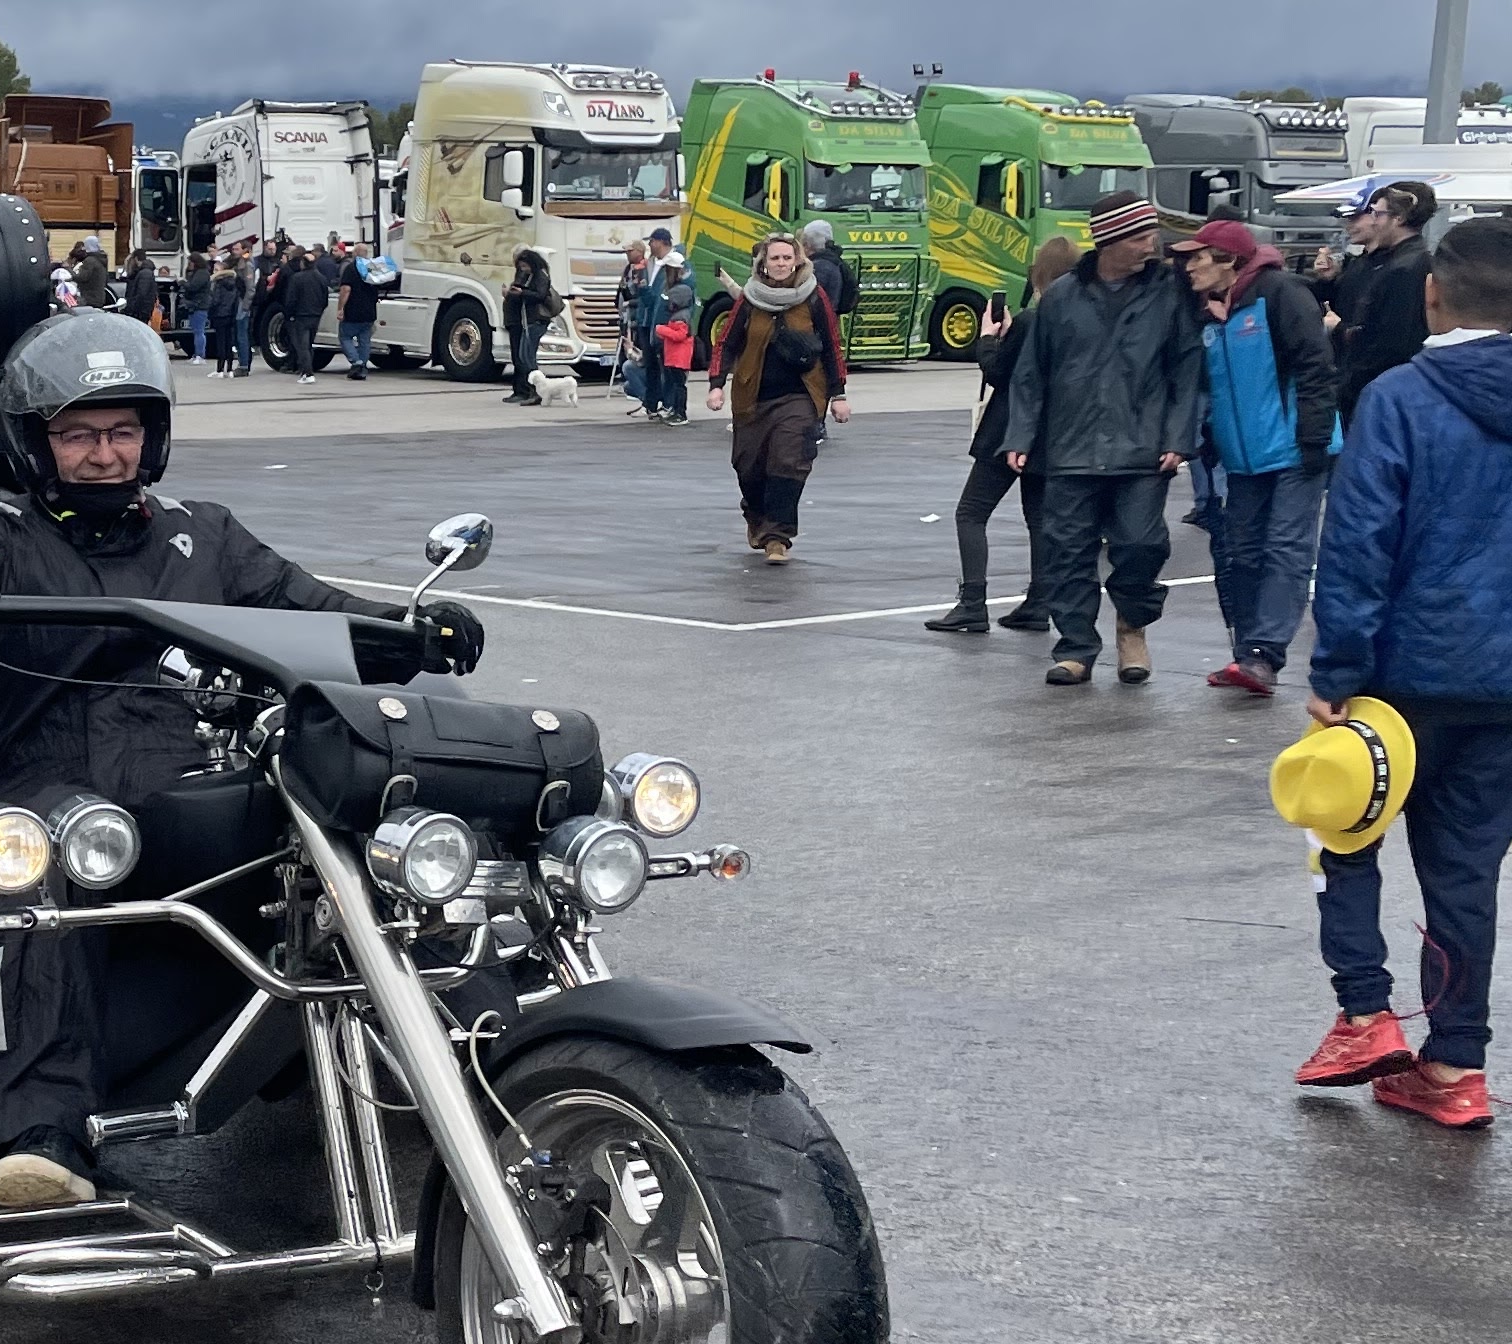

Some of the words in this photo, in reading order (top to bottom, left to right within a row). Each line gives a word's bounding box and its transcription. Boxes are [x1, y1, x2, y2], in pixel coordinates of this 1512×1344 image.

[274, 131, 329, 144] SCANIA
[929, 187, 961, 219] DA
[966, 206, 1030, 264] SILVA
[847, 230, 908, 243] VOLVO
[88, 370, 127, 382] HJC
